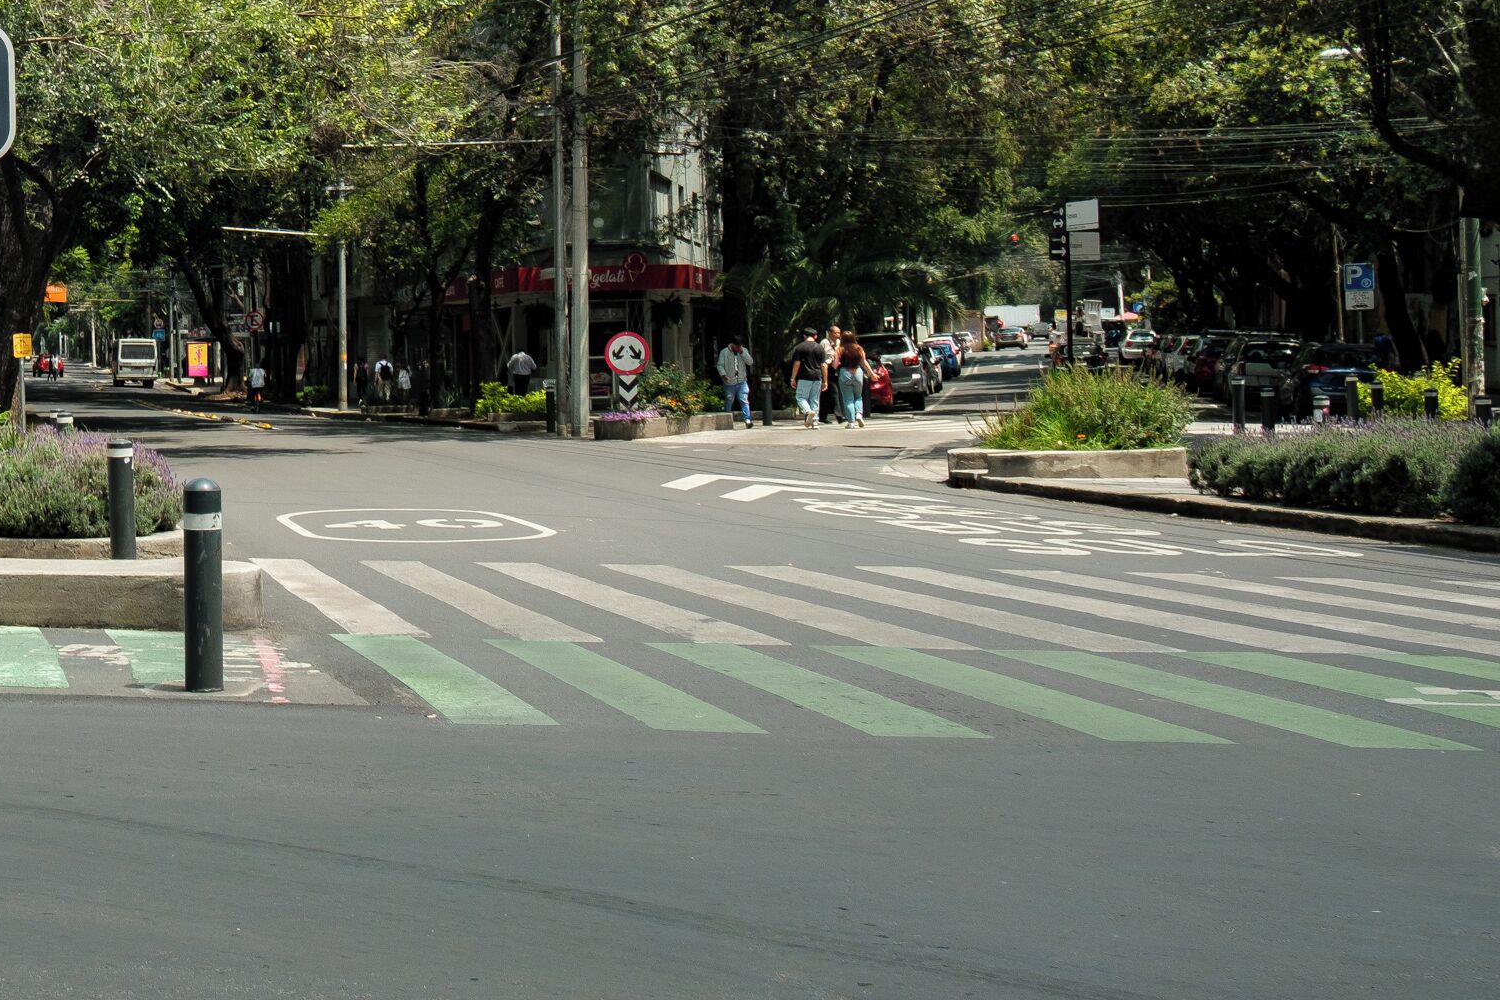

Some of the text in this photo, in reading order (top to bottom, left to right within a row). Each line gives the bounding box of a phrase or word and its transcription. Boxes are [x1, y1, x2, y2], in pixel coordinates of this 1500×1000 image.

[590, 269, 626, 289] gelati
[1346, 265, 1363, 285] P
[325, 518, 504, 530] 40
